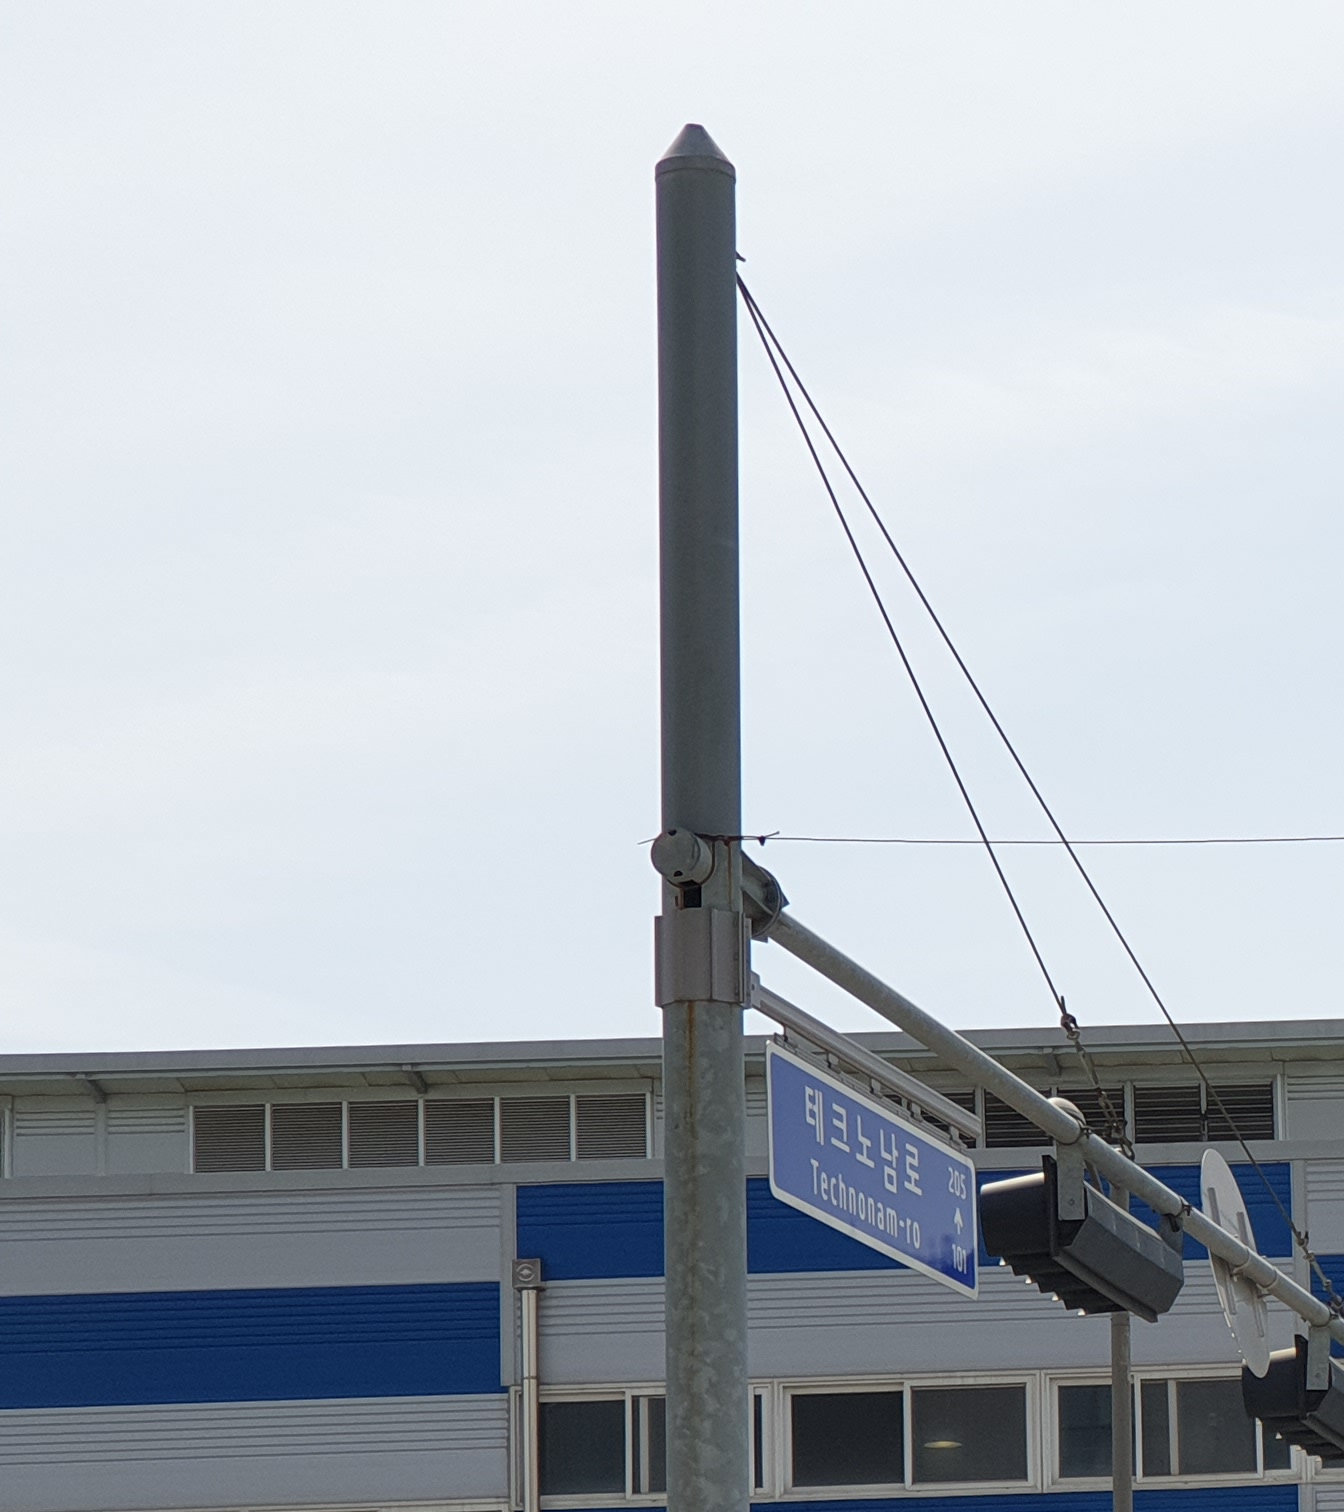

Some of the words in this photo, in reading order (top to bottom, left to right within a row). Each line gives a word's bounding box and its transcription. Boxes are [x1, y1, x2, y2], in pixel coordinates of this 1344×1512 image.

[804, 1086, 922, 1196] 테크노남로
[810, 1158, 920, 1249] Technonam-ro
[948, 1167, 967, 1200] 205
[952, 1244, 967, 1275] 101
